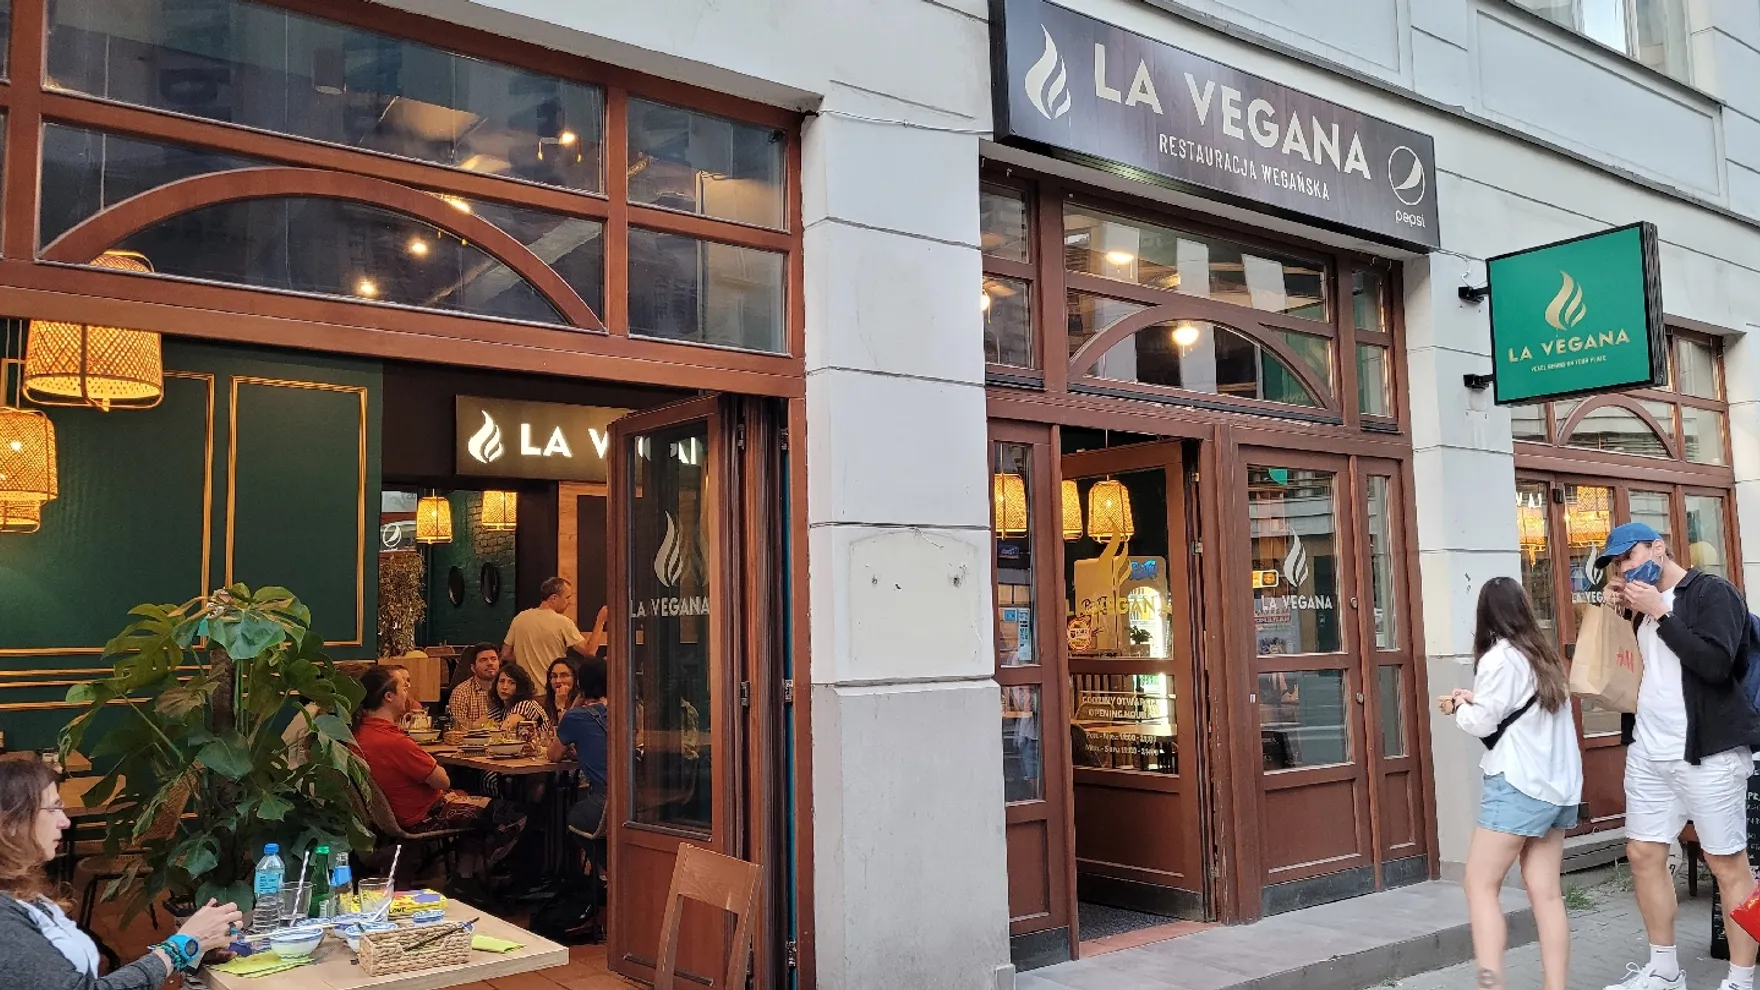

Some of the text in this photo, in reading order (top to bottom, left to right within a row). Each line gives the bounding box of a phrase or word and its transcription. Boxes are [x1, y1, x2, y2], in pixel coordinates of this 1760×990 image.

[1094, 42, 1371, 181] LA VEGANA
[1159, 133, 1330, 201] RESTAURACJA WEGAŃSKA
[1395, 208, 1426, 229] pepsi
[1508, 328, 1630, 363] LA VEGANA
[520, 423, 573, 457] LA
[630, 596, 710, 618] LA VEGANA
[1261, 594, 1333, 611] LA VEGANA
[1585, 591, 1605, 603] VEG
